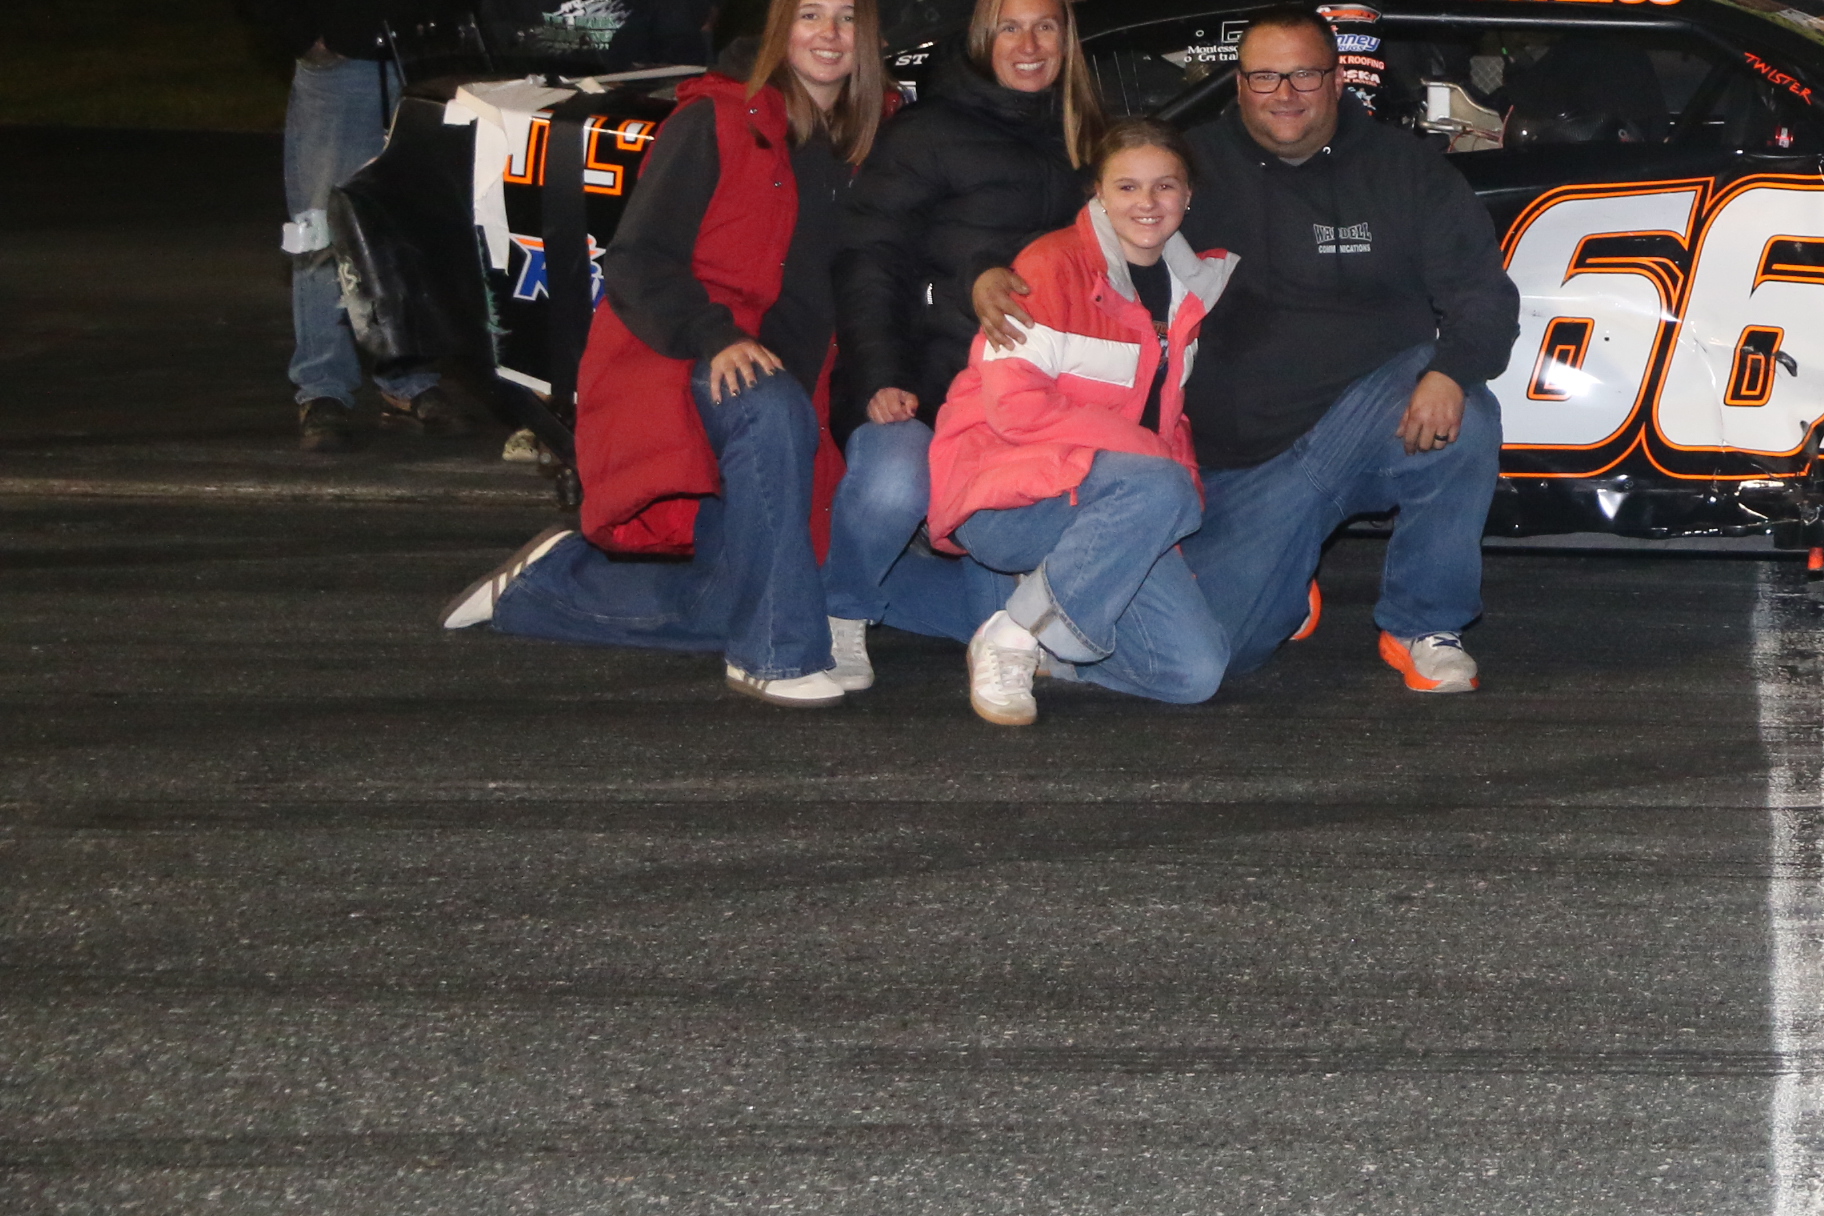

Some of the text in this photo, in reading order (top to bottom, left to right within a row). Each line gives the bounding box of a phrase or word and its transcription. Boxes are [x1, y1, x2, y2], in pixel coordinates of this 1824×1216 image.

[1335, 33, 1380, 52] nney
[1347, 55, 1385, 70] ROOFING
[1343, 69, 1381, 84] SKA
[1744, 52, 1813, 105] TWISTER
[1313, 222, 1373, 244] WADELL
[1318, 244, 1371, 254] COMMNICATIONS
